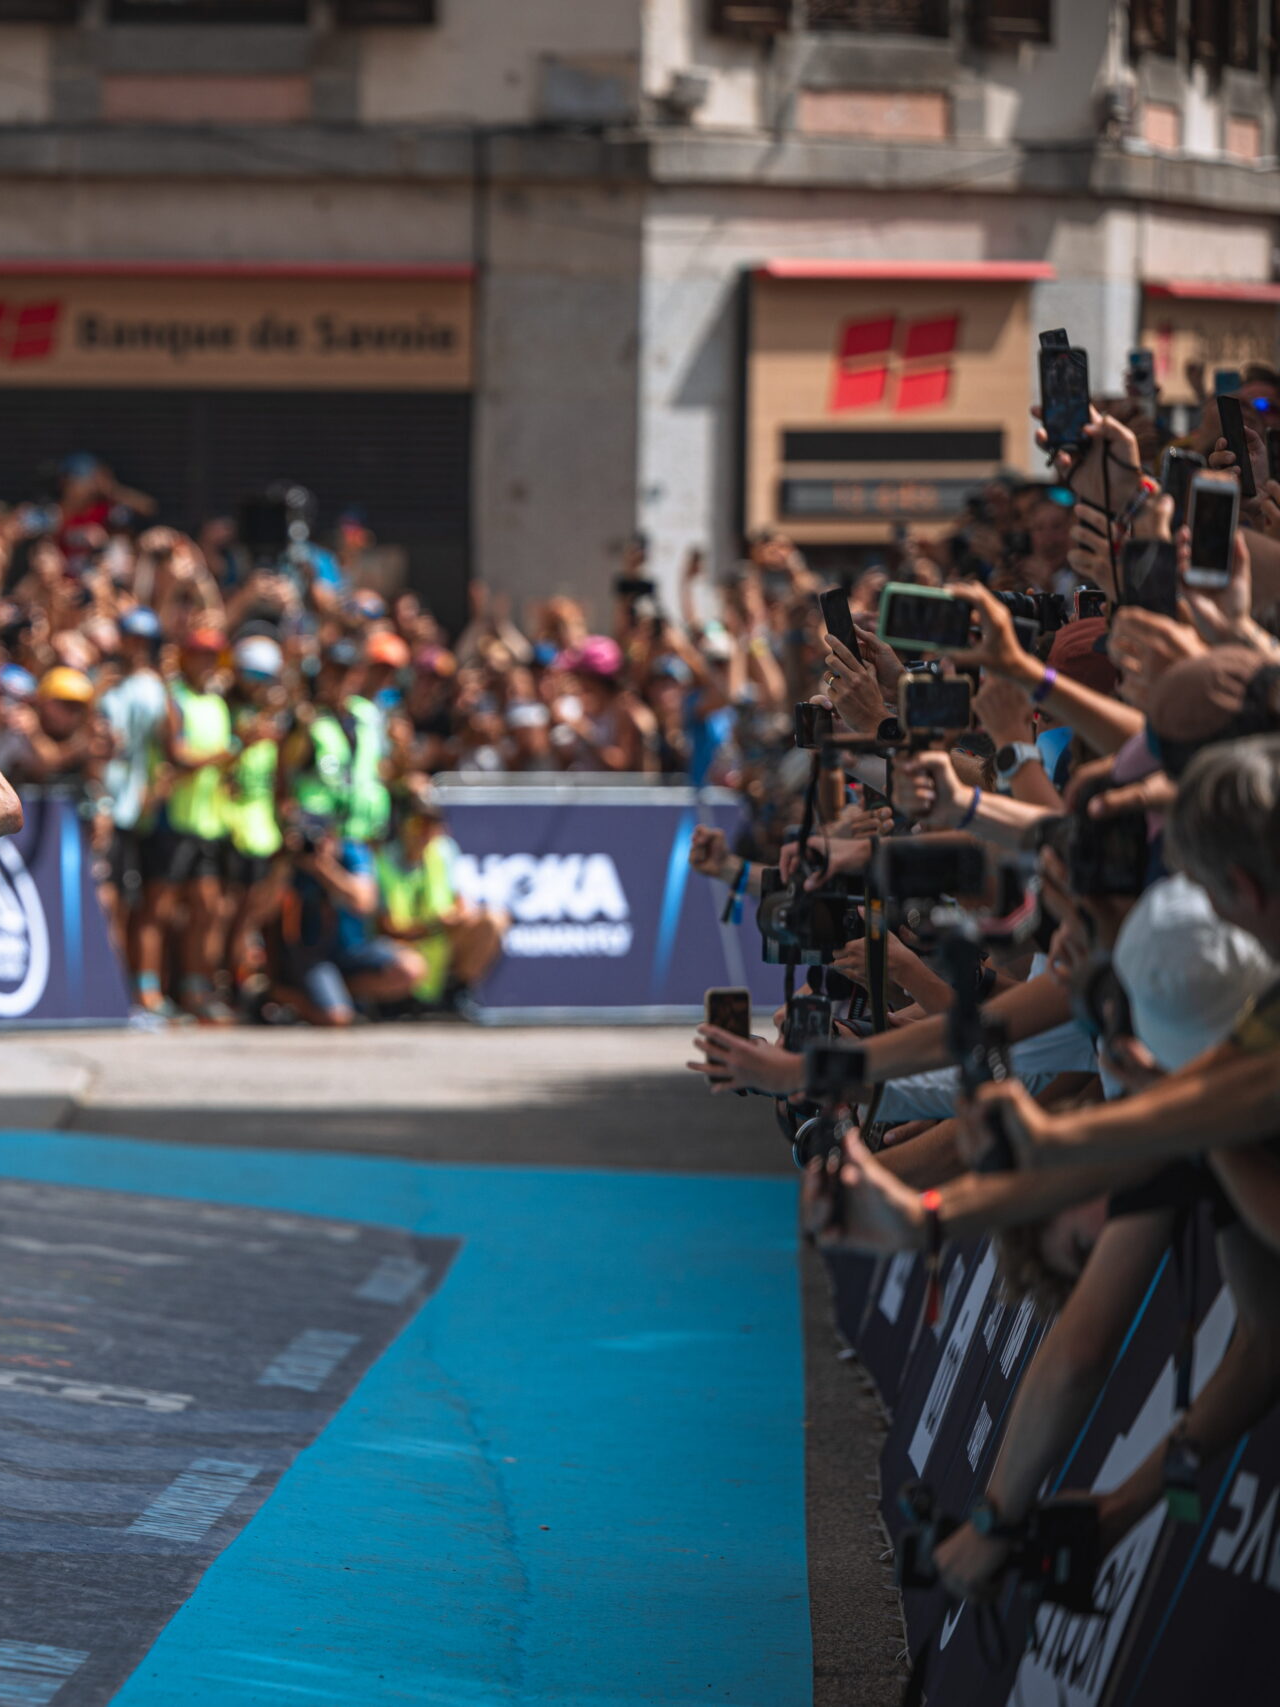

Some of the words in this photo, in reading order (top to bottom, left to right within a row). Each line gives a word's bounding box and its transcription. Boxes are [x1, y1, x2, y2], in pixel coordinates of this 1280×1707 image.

[77, 312, 234, 361] Banque
[250, 312, 298, 352] de
[314, 311, 458, 352] Savoie
